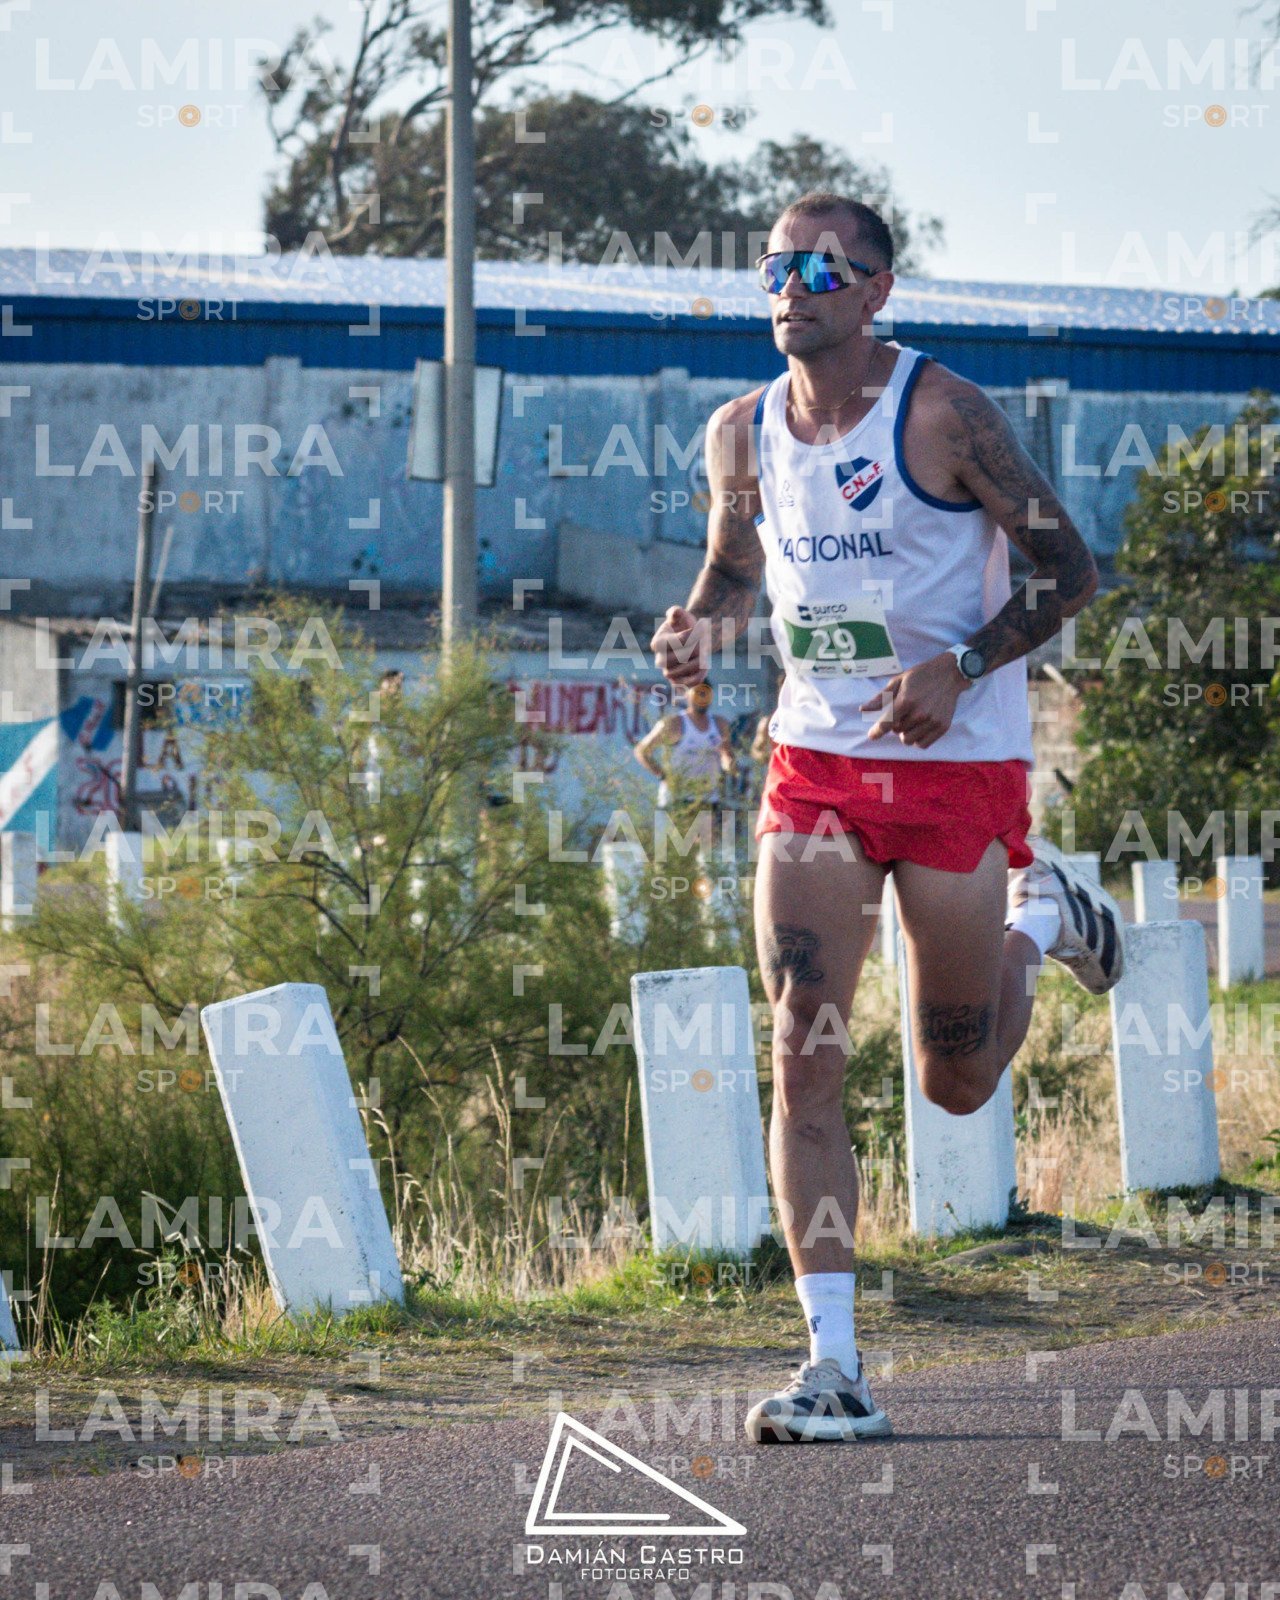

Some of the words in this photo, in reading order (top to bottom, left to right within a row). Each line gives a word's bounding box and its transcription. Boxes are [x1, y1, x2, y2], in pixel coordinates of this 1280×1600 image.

[778, 531, 894, 563] ACIONAL
[812, 603, 848, 615] surco
[810, 628, 858, 660] 29
